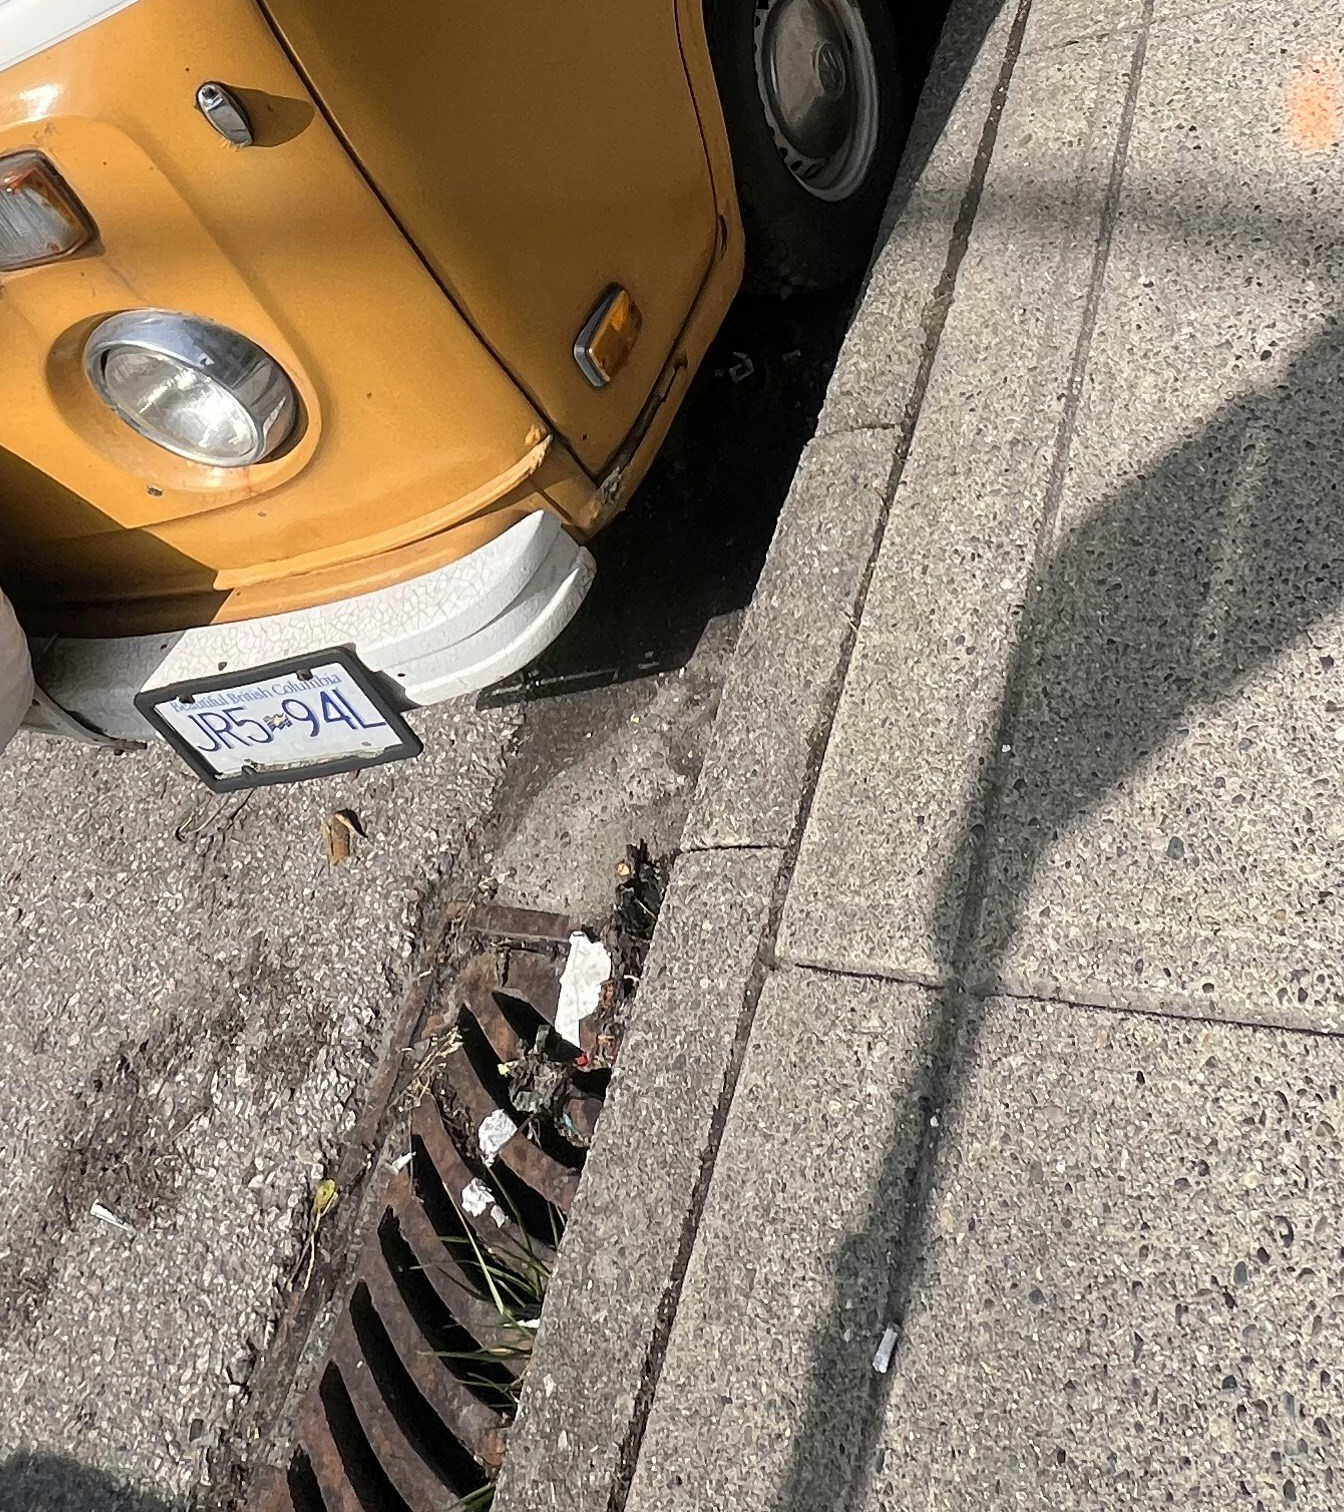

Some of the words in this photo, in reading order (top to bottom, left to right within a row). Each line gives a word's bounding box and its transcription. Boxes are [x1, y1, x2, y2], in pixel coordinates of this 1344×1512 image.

[229, 686, 273, 706] British
[274, 672, 343, 698] Columbia
[187, 706, 273, 753] JR5
[281, 687, 386, 737] 94L
